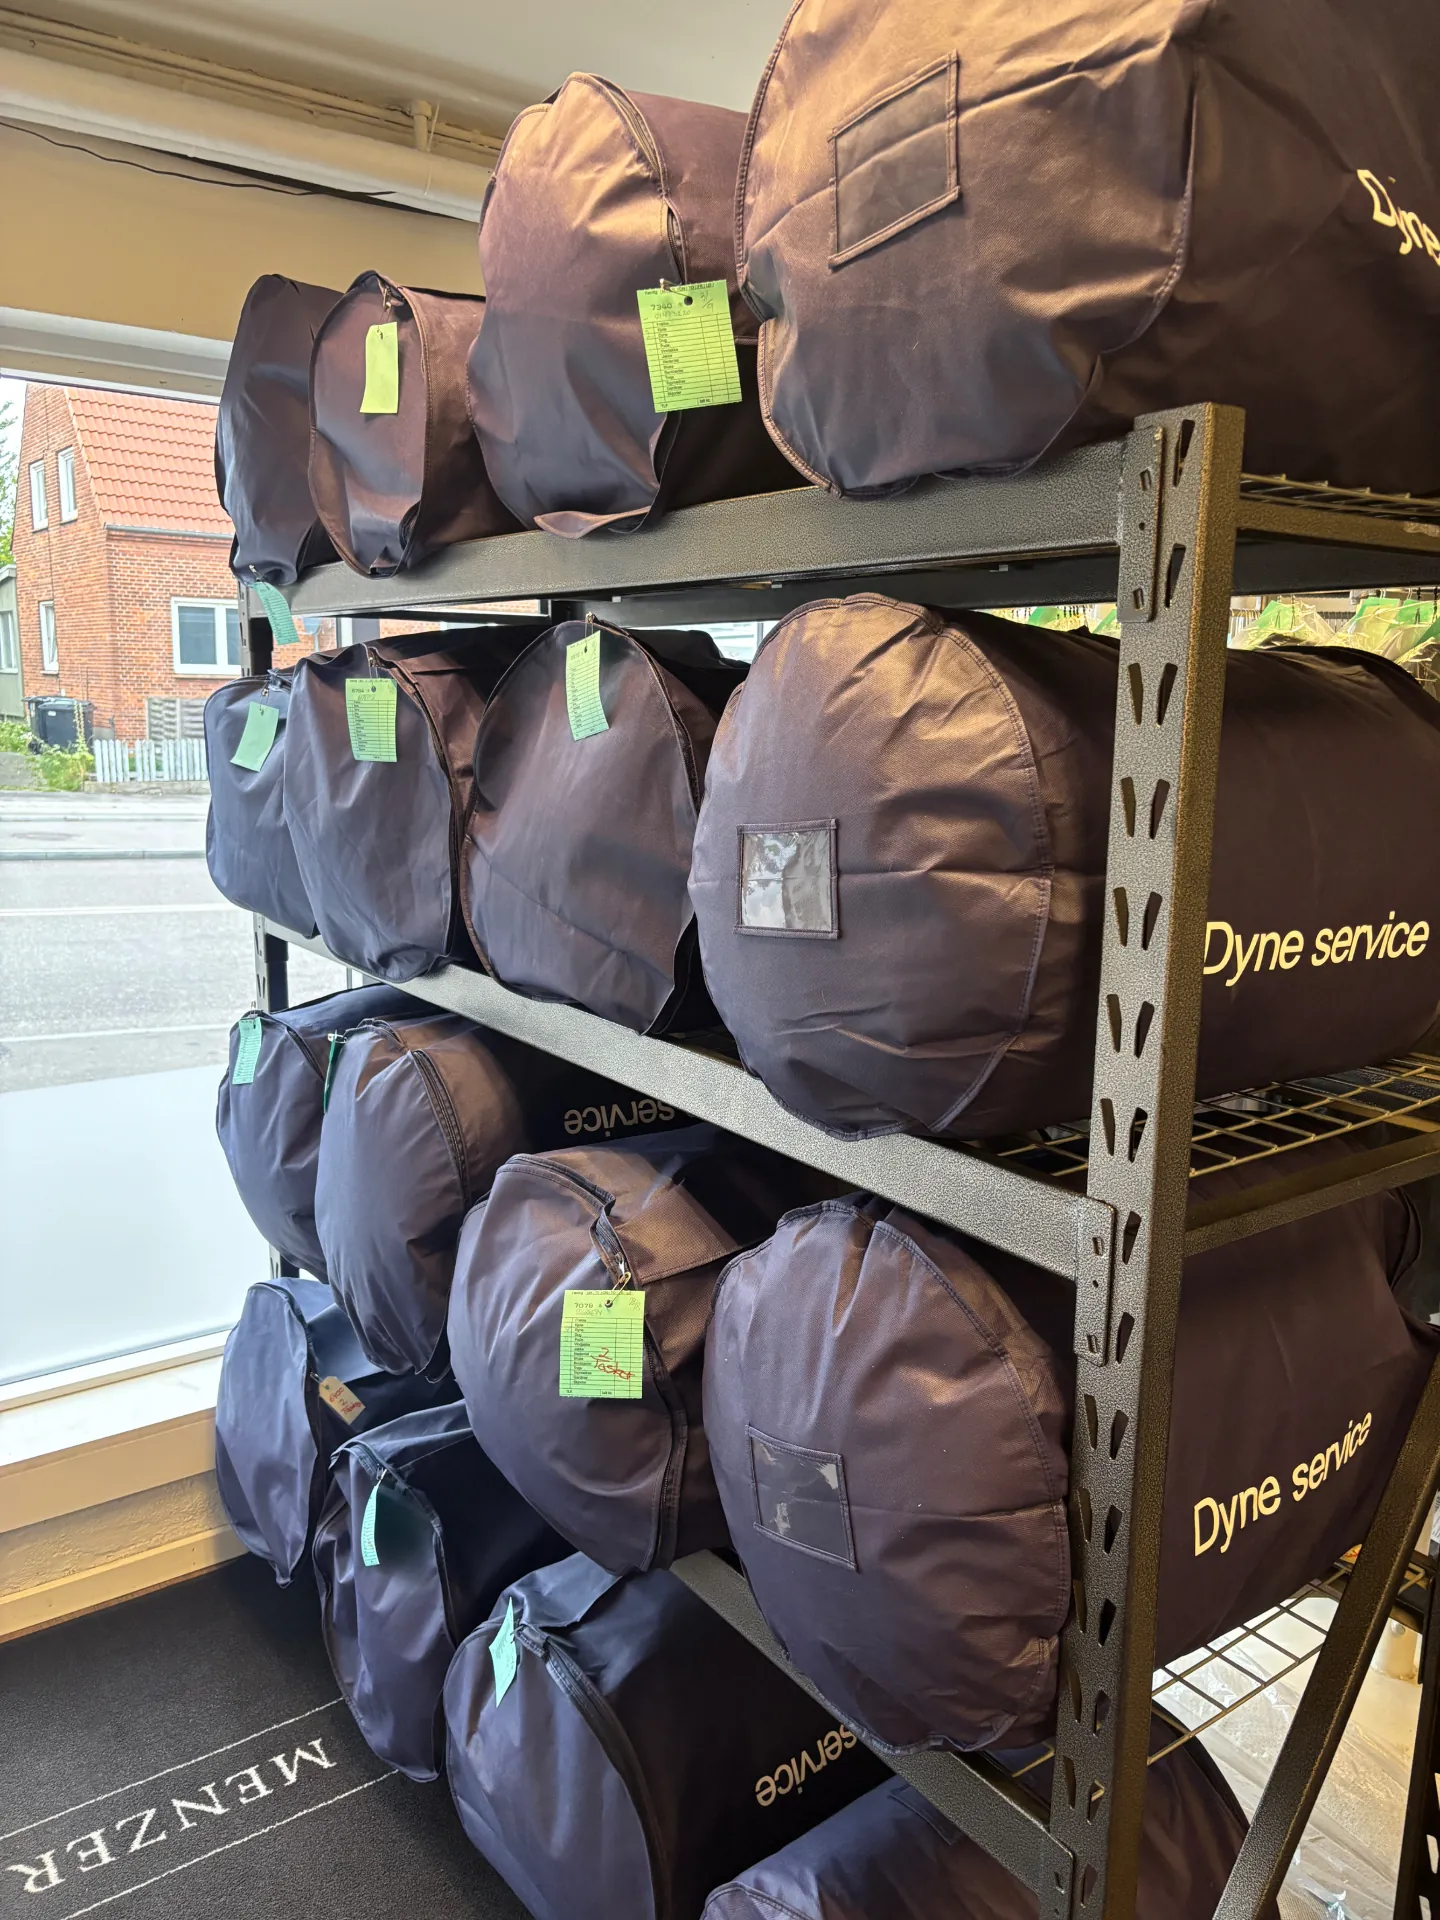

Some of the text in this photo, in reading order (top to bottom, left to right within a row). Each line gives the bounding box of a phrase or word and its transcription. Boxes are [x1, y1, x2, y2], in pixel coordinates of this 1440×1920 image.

[1203, 910, 1430, 986] Dyne service
[563, 1098, 675, 1137] service
[598, 1347, 613, 1360] 2
[1194, 1412, 1372, 1557] Dyne service
[755, 1723, 857, 1807] service
[5, 1738, 337, 1893] MENZER
